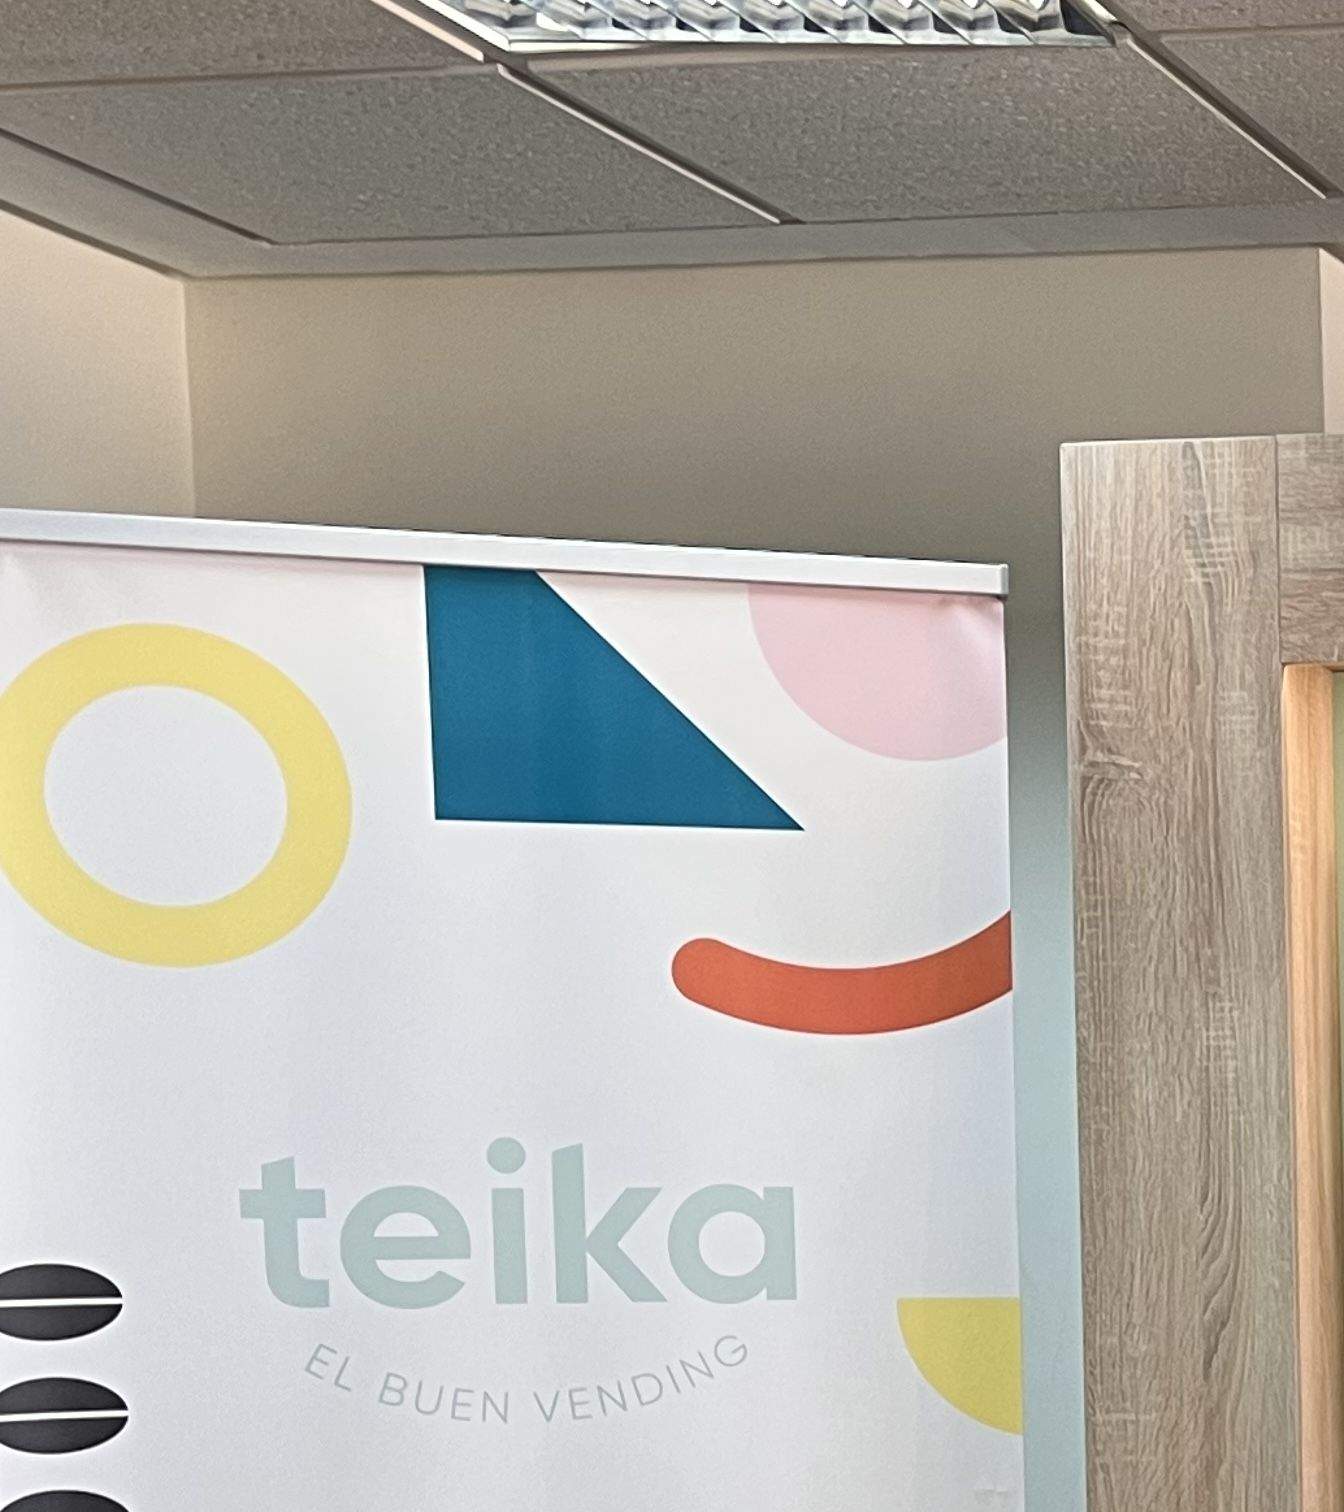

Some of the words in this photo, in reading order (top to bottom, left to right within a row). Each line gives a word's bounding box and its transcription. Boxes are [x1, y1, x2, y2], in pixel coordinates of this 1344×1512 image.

[239, 1136, 798, 1310] teika
[304, 1342, 352, 1392] EL
[378, 1372, 509, 1425] BUEN
[533, 1334, 749, 1423] VENDING
